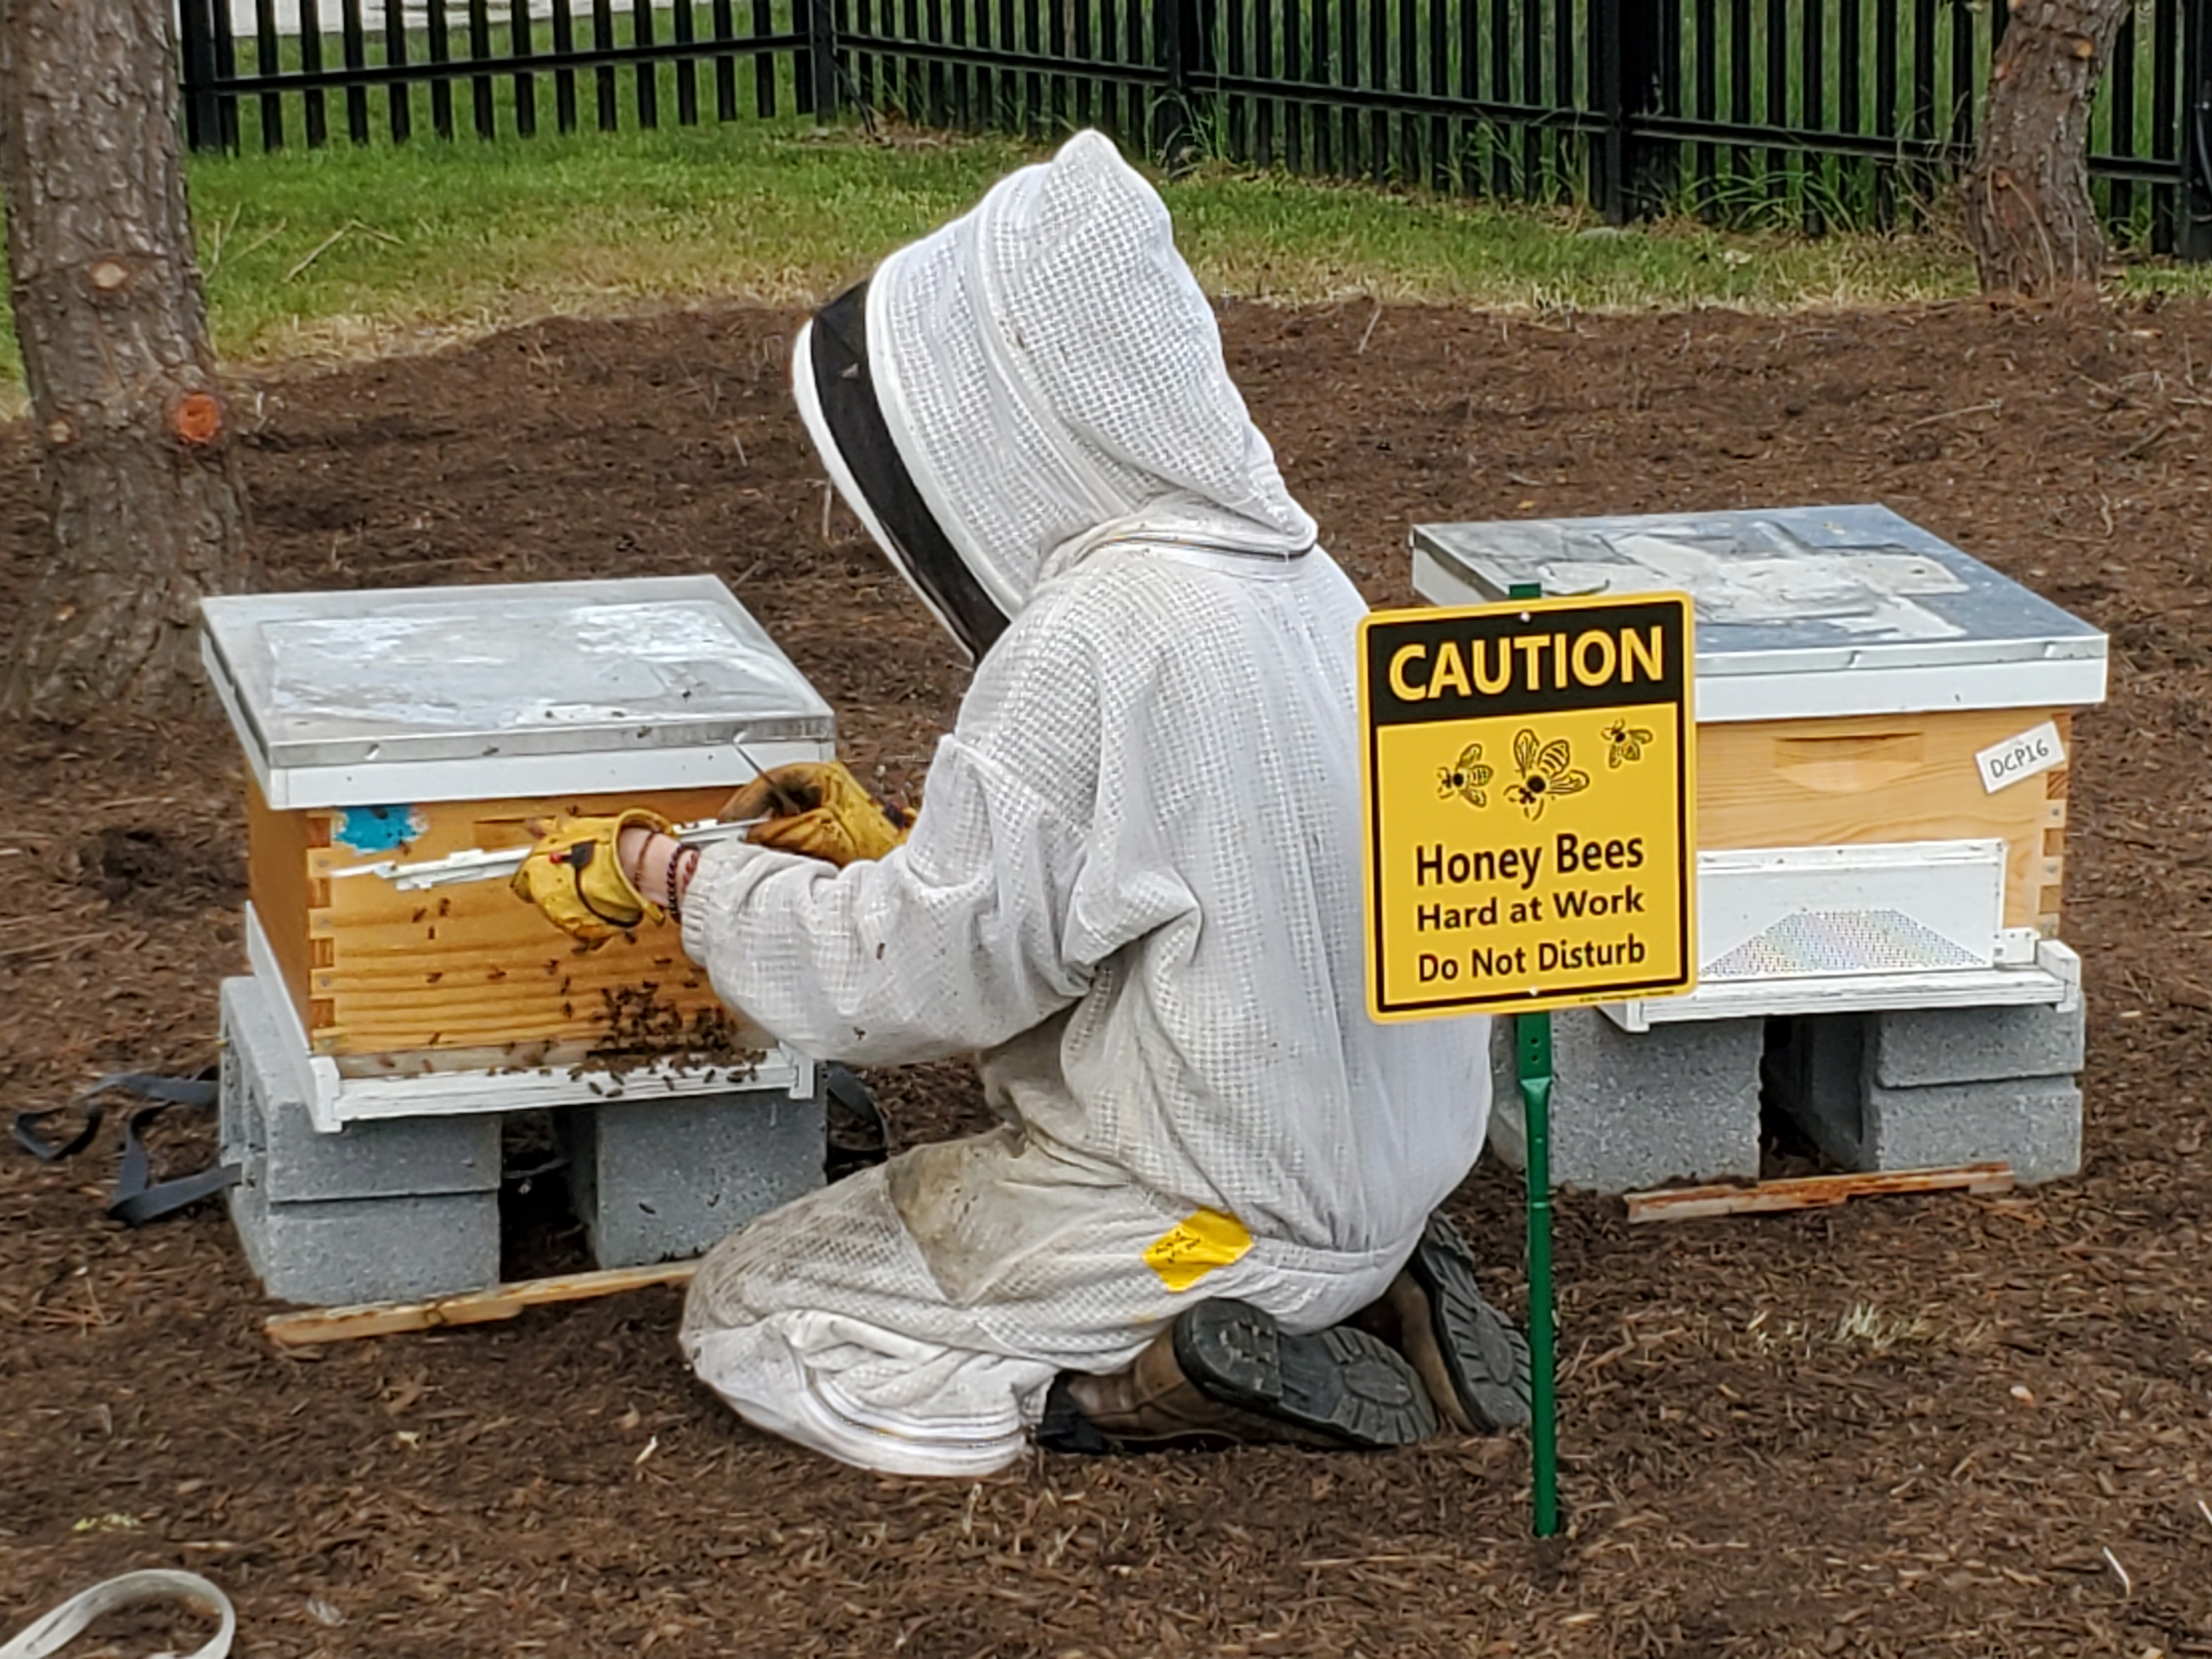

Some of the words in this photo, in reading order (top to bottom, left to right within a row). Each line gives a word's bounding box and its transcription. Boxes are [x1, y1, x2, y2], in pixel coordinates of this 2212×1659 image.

[1389, 626, 1663, 701] CAUTION
[1990, 738, 2049, 778] DCP16
[1416, 847, 1543, 890] Honey
[1556, 833, 1644, 874] Bees
[1417, 896, 1498, 932] Hard
[1509, 896, 1543, 924] at
[1553, 884, 1645, 919] Work
[1419, 953, 1459, 983] Do
[1471, 947, 1526, 978] Not
[1538, 933, 1645, 972] Disturb
